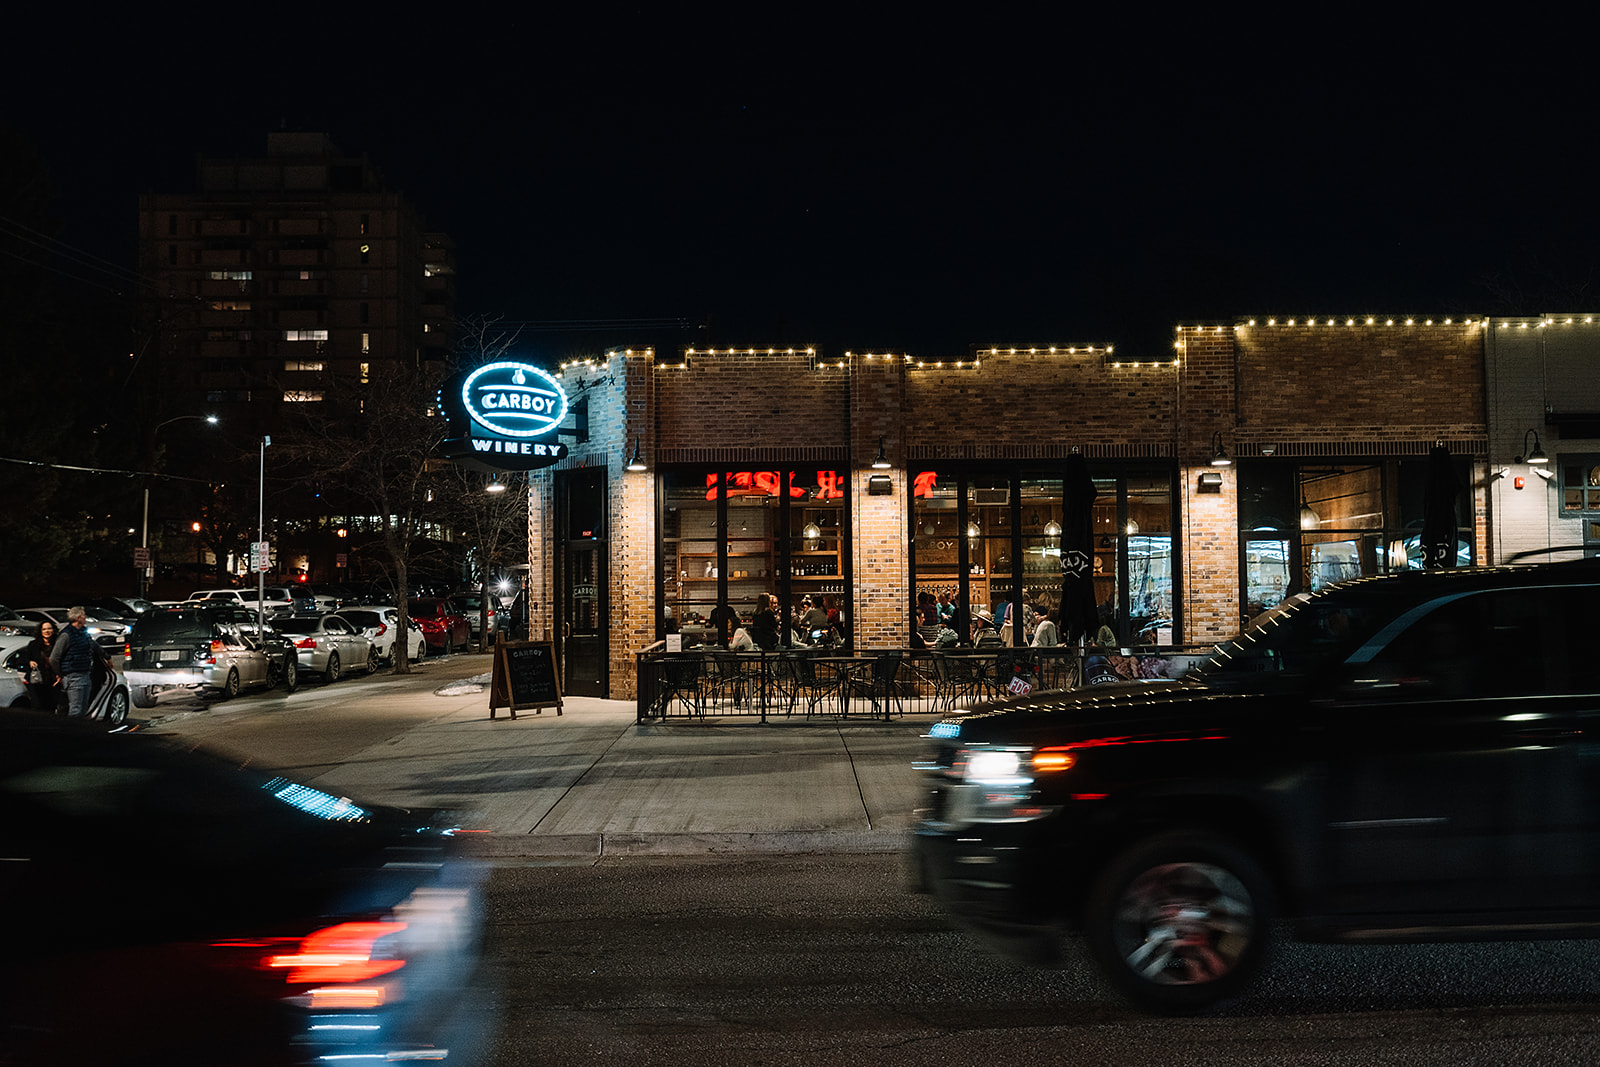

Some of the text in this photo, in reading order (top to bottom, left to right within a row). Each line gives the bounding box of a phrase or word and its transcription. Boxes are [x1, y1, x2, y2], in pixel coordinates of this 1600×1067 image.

[481, 392, 556, 415] CARBOY
[471, 438, 562, 457] WINERY
[1009, 678, 1030, 695] FDC
[1091, 677, 1120, 686] CARBO
